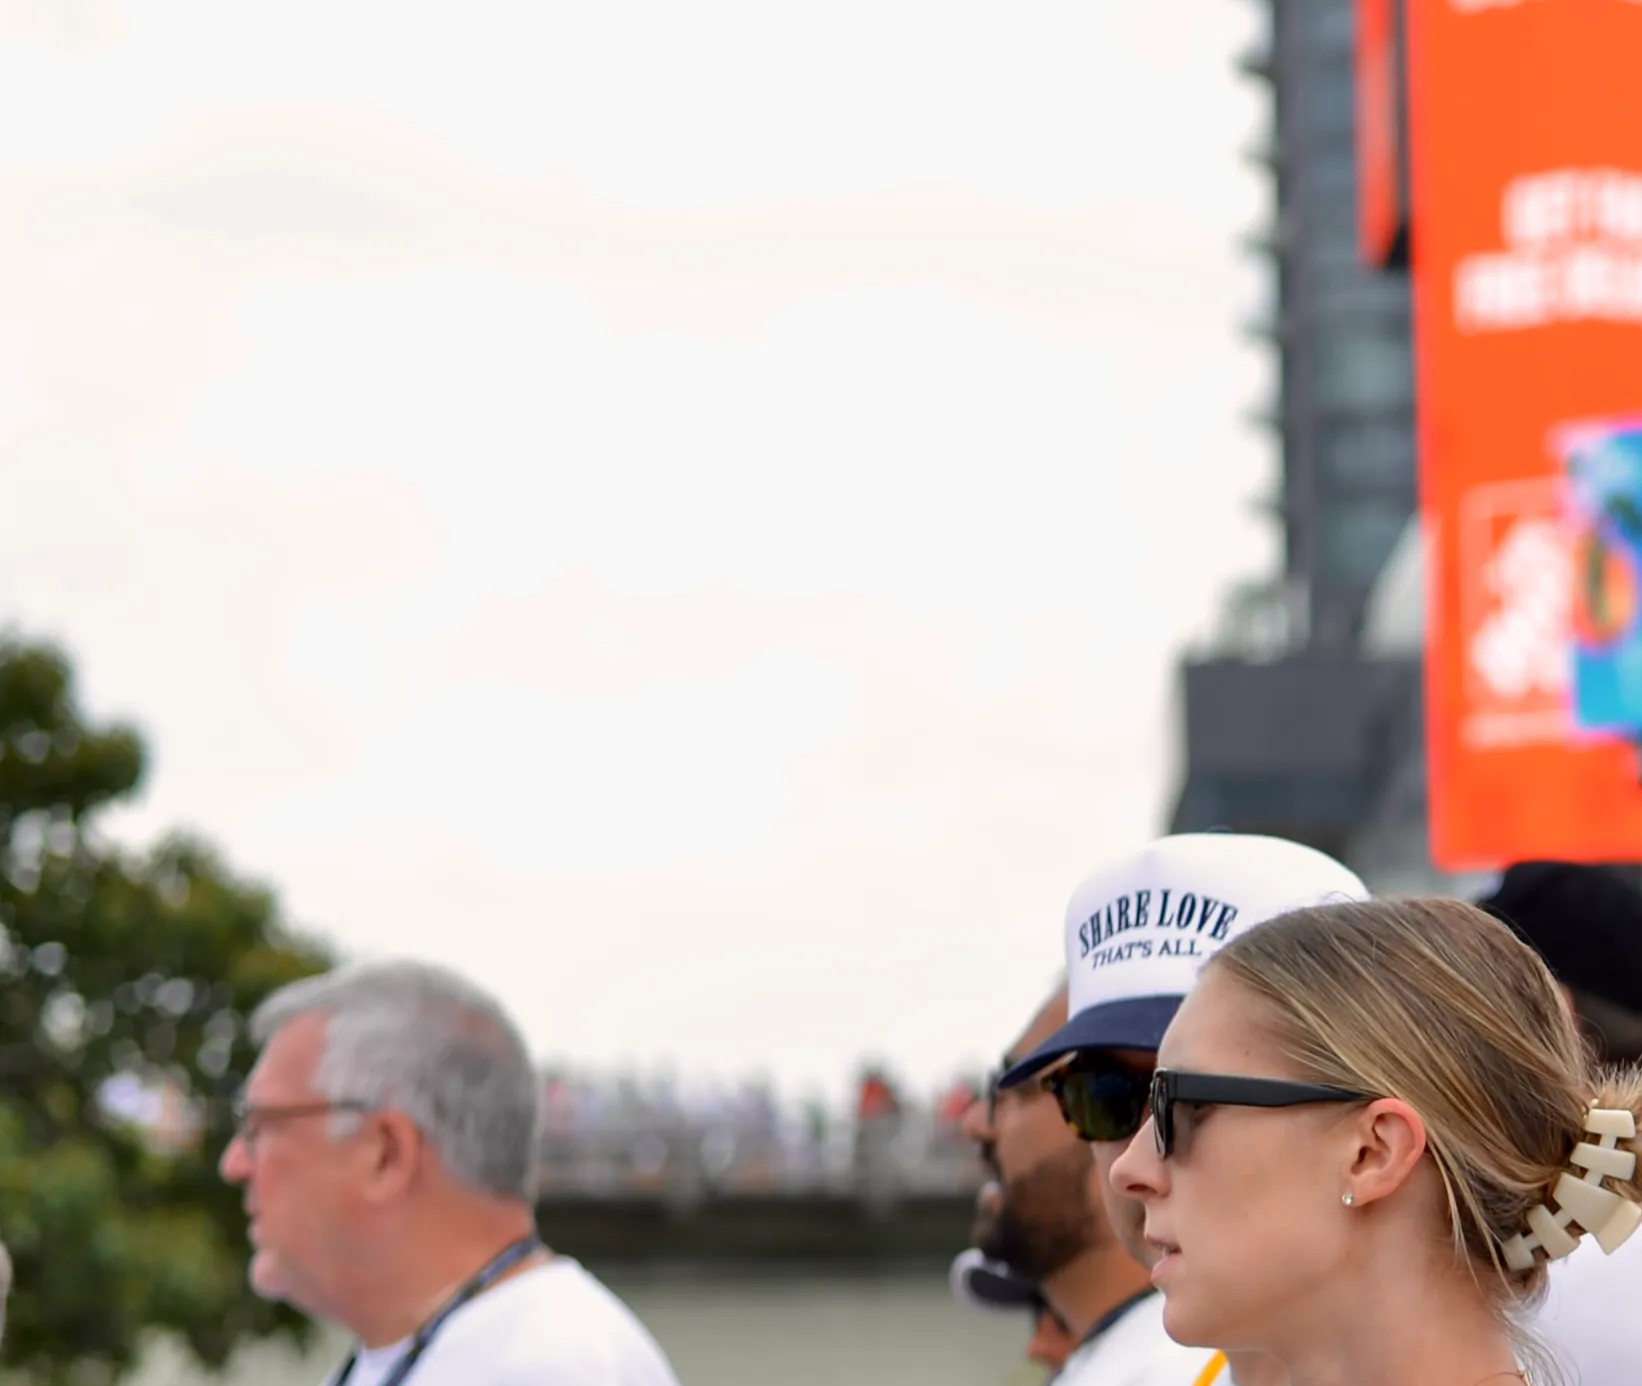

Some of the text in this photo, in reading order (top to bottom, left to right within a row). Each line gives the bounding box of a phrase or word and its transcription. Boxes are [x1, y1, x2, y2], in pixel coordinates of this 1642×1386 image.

[1079, 889, 1240, 959] SHARE LOVE
[1091, 938, 1203, 971] THAT'S ALL
